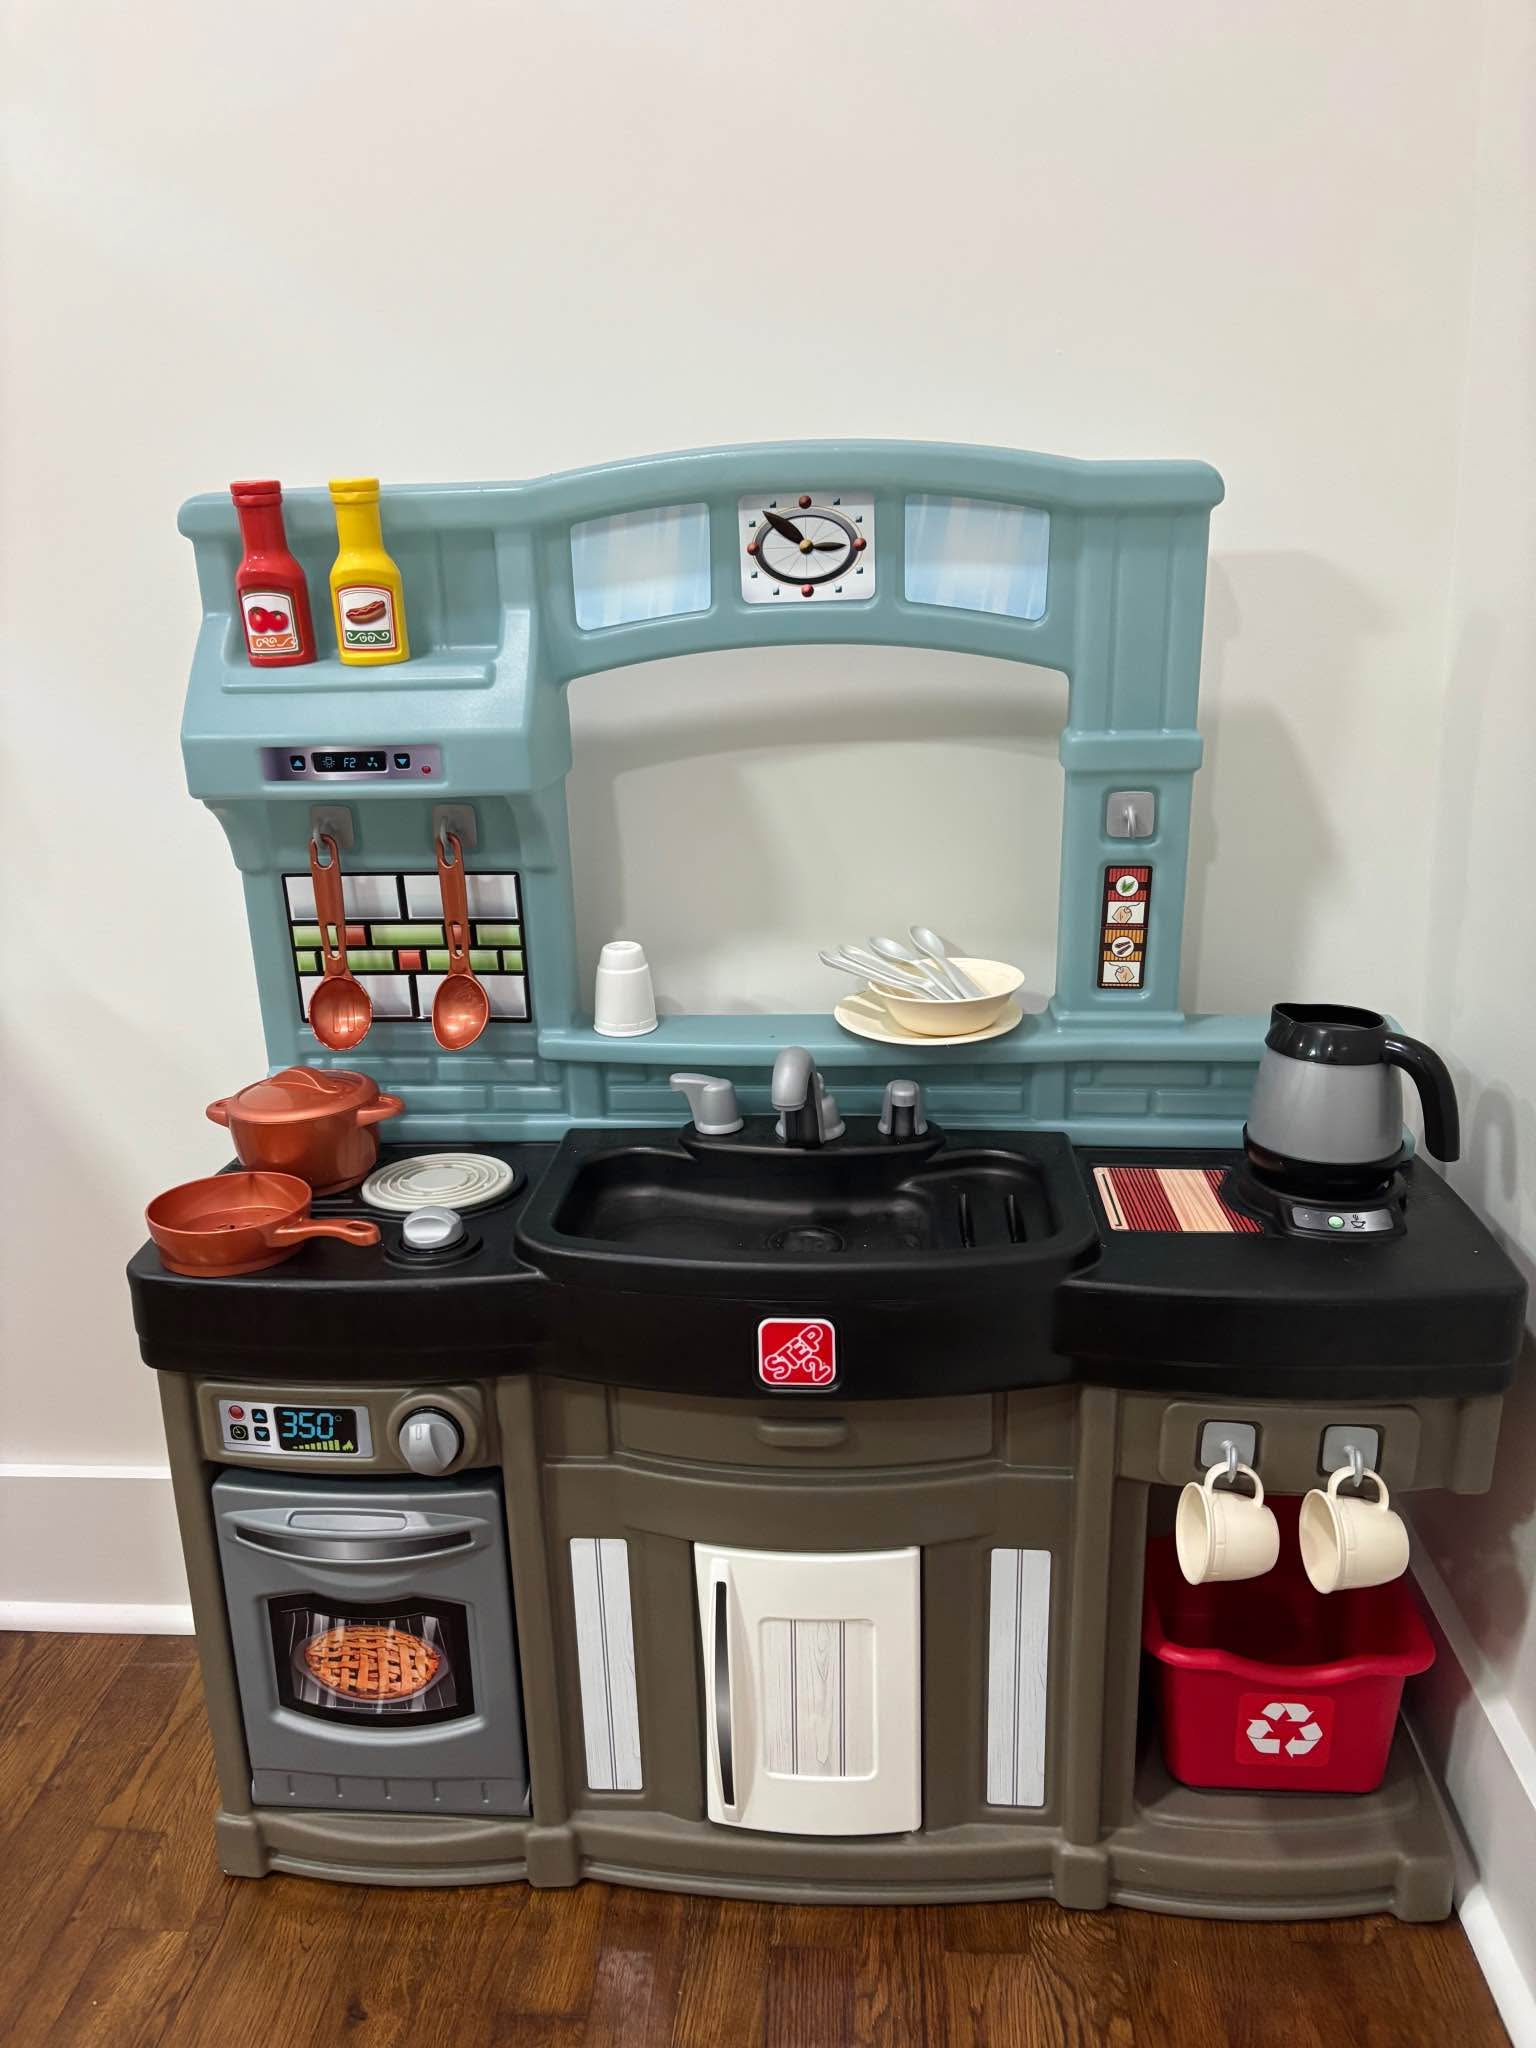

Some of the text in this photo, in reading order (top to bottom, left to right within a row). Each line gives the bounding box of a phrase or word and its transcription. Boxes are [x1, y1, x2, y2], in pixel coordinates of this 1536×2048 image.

[343, 757, 357, 769] F2
[764, 1324, 824, 1380] STEP
[802, 1355, 831, 1382] 2
